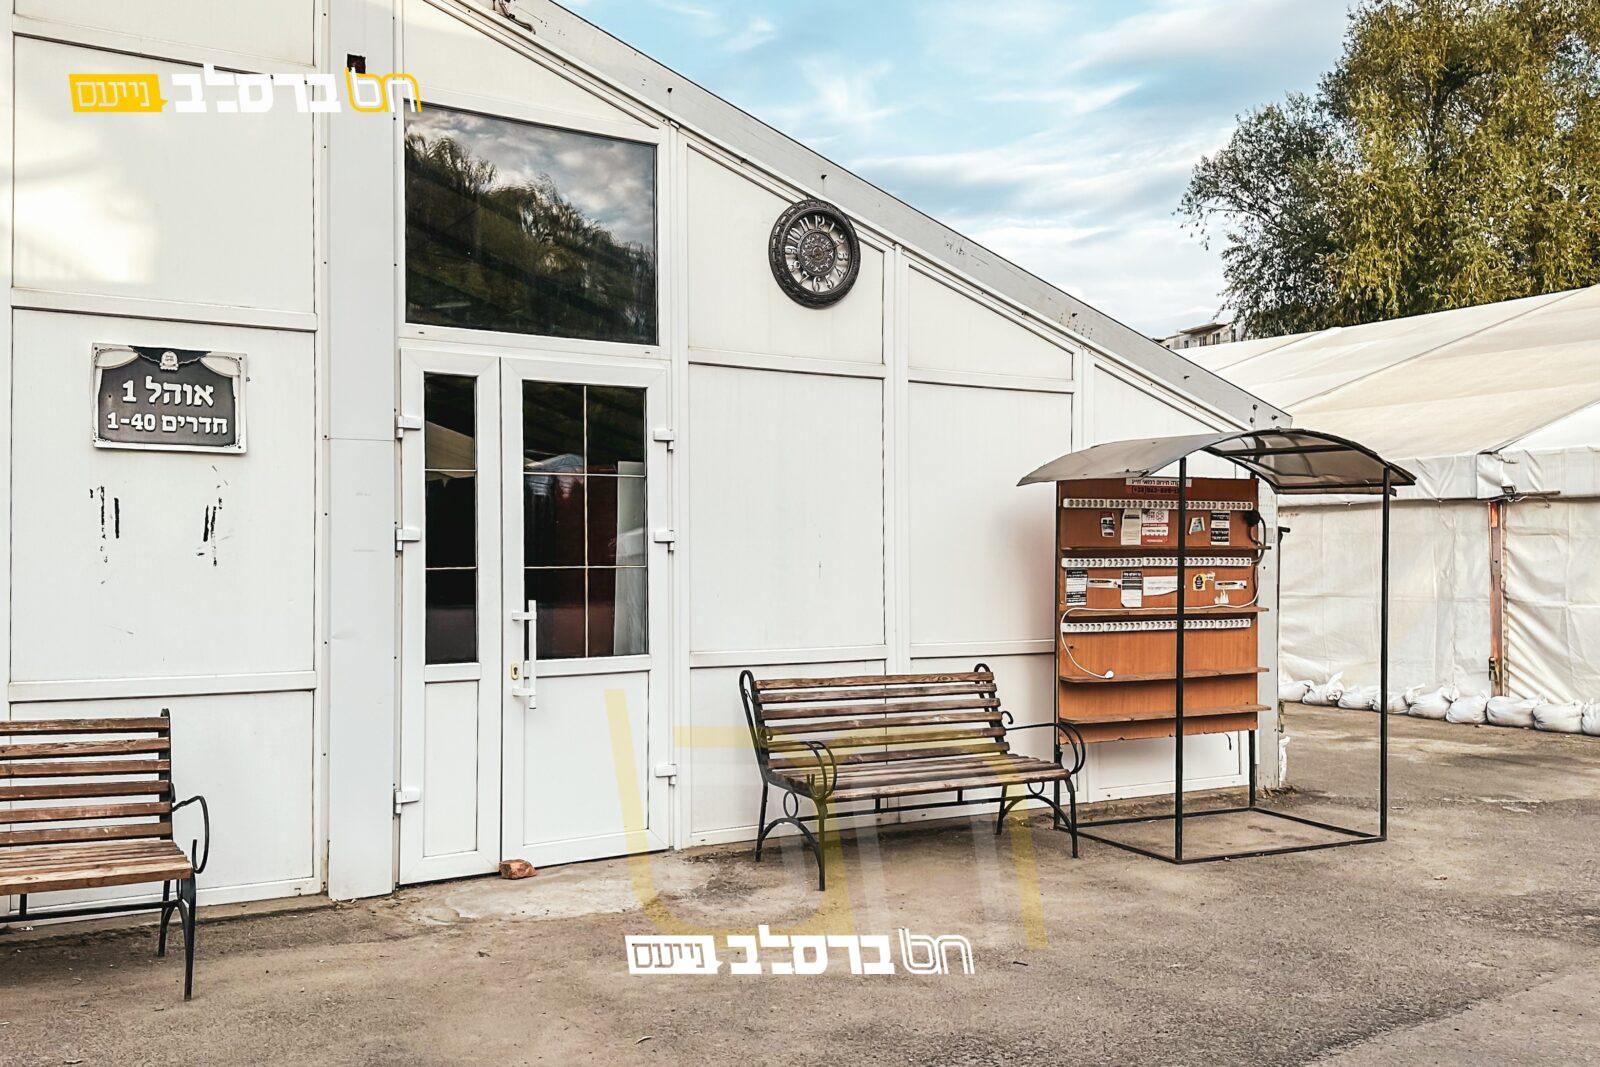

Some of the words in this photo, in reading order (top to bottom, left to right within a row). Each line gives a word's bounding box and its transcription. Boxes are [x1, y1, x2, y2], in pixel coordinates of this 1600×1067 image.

[122, 380, 137, 403] 1
[145, 375, 214, 407] אוהל
[107, 411, 157, 432] 1-40
[161, 414, 228, 434] חדרים
